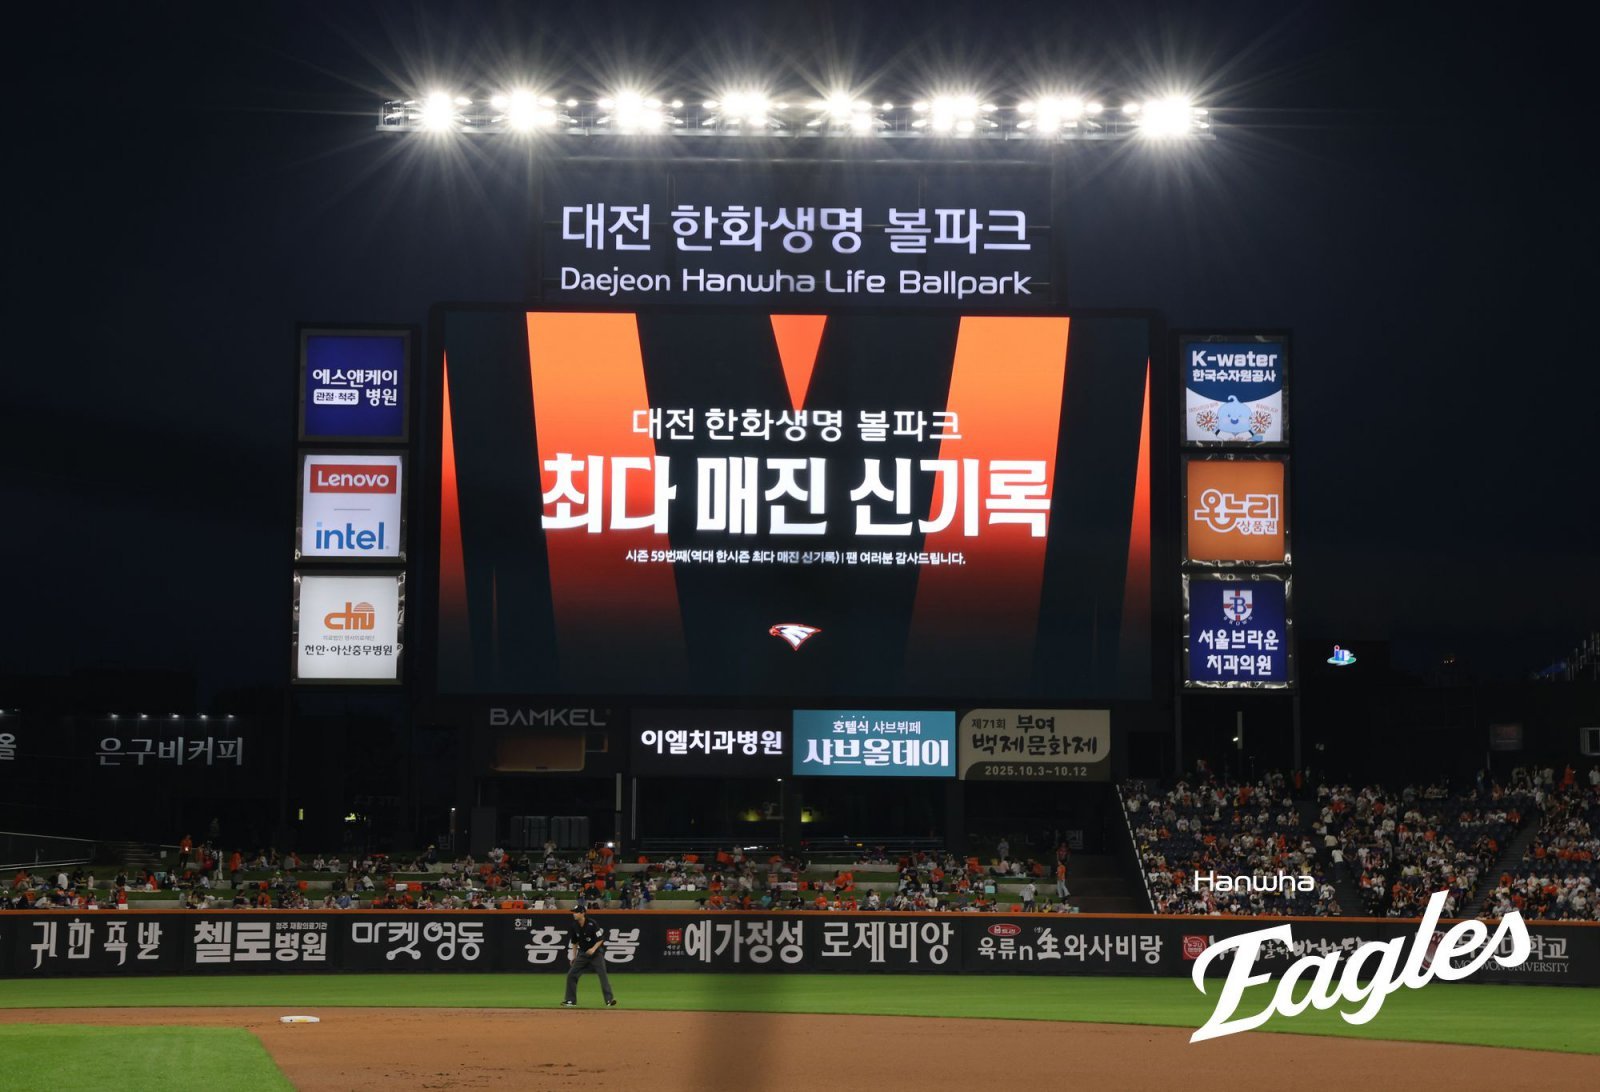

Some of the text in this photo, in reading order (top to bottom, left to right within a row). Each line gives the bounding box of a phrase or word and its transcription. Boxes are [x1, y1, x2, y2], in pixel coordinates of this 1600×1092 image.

[562, 203, 1032, 254] 대전 한화생명 볼파크
[560, 267, 1032, 299] Daejeon Hanwha Life Ballpark
[1192, 350, 1278, 367] K-water
[312, 369, 398, 387] 에스앤케이
[1193, 369, 1276, 382] 한국수자원공사
[366, 388, 397, 407] 병원
[632, 408, 963, 443] 대전 한화생명 볼파크
[317, 470, 390, 488] Lenovo
[541, 453, 1052, 538] 최다 매진 신기록
[315, 522, 386, 551] intel
[1239, 520, 1277, 534] 상품권
[626, 550, 649, 562] 시즌
[651, 550, 714, 564] 59번째(역대
[716, 550, 750, 563] 한시즌
[752, 551, 775, 563] 최다
[777, 551, 799, 563] 매진
[846, 552, 857, 564] 팬
[860, 552, 893, 564] 여러분
[896, 552, 966, 566] 감사드립니다.
[1198, 629, 1279, 651] 서울브라운
[1207, 654, 1272, 676] 치과의원
[490, 707, 607, 726] BAMKEL
[832, 720, 921, 735] 호텔식 샤브뷔페
[971, 714, 1055, 733] 제71회 부여
[96, 737, 243, 765] 은구비커피
[641, 729, 783, 757] 이엘치과병원
[803, 738, 949, 767] 샤브올데이
[972, 733, 1097, 756] 백제문화제
[984, 765, 1088, 778] 2025.10.3~10.12
[31, 918, 163, 969] 귀한족발
[525, 926, 640, 964] 홈볼
[684, 920, 804, 963] 예가정성
[821, 921, 955, 965] 로제비앙
